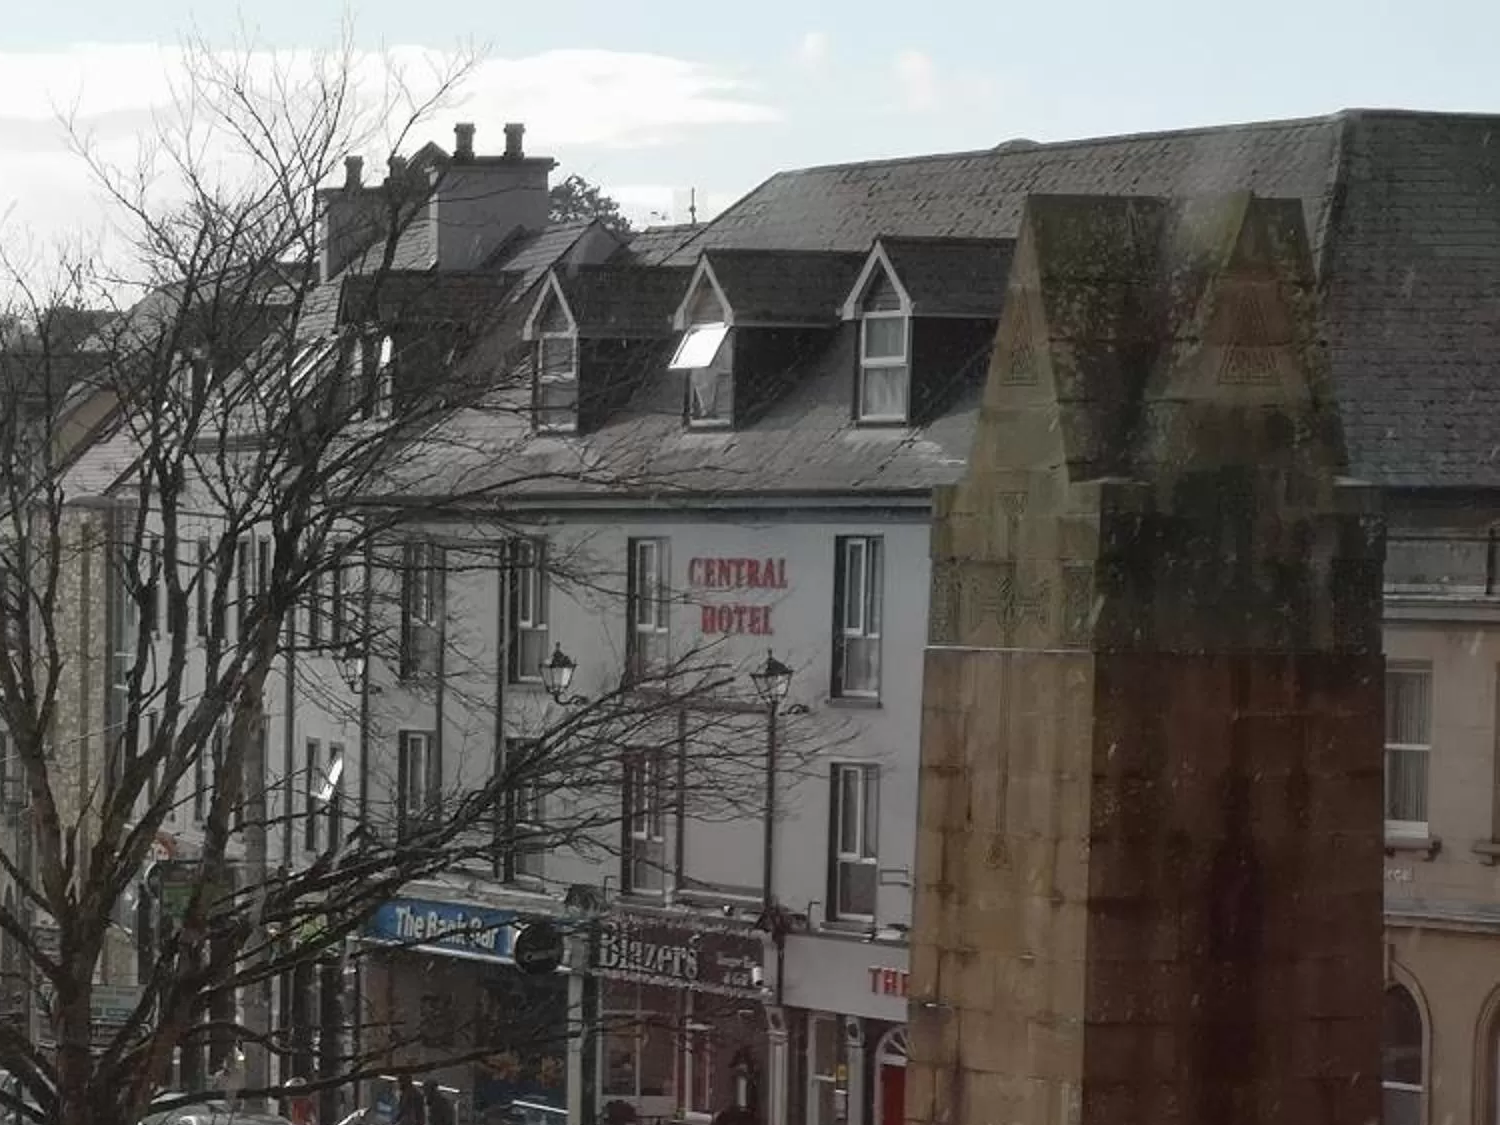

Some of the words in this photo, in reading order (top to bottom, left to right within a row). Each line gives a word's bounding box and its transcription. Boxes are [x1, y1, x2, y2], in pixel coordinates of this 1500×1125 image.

[688, 558, 788, 588] CENTRAL
[701, 605, 772, 634] HOTEL
[396, 906, 425, 938] The
